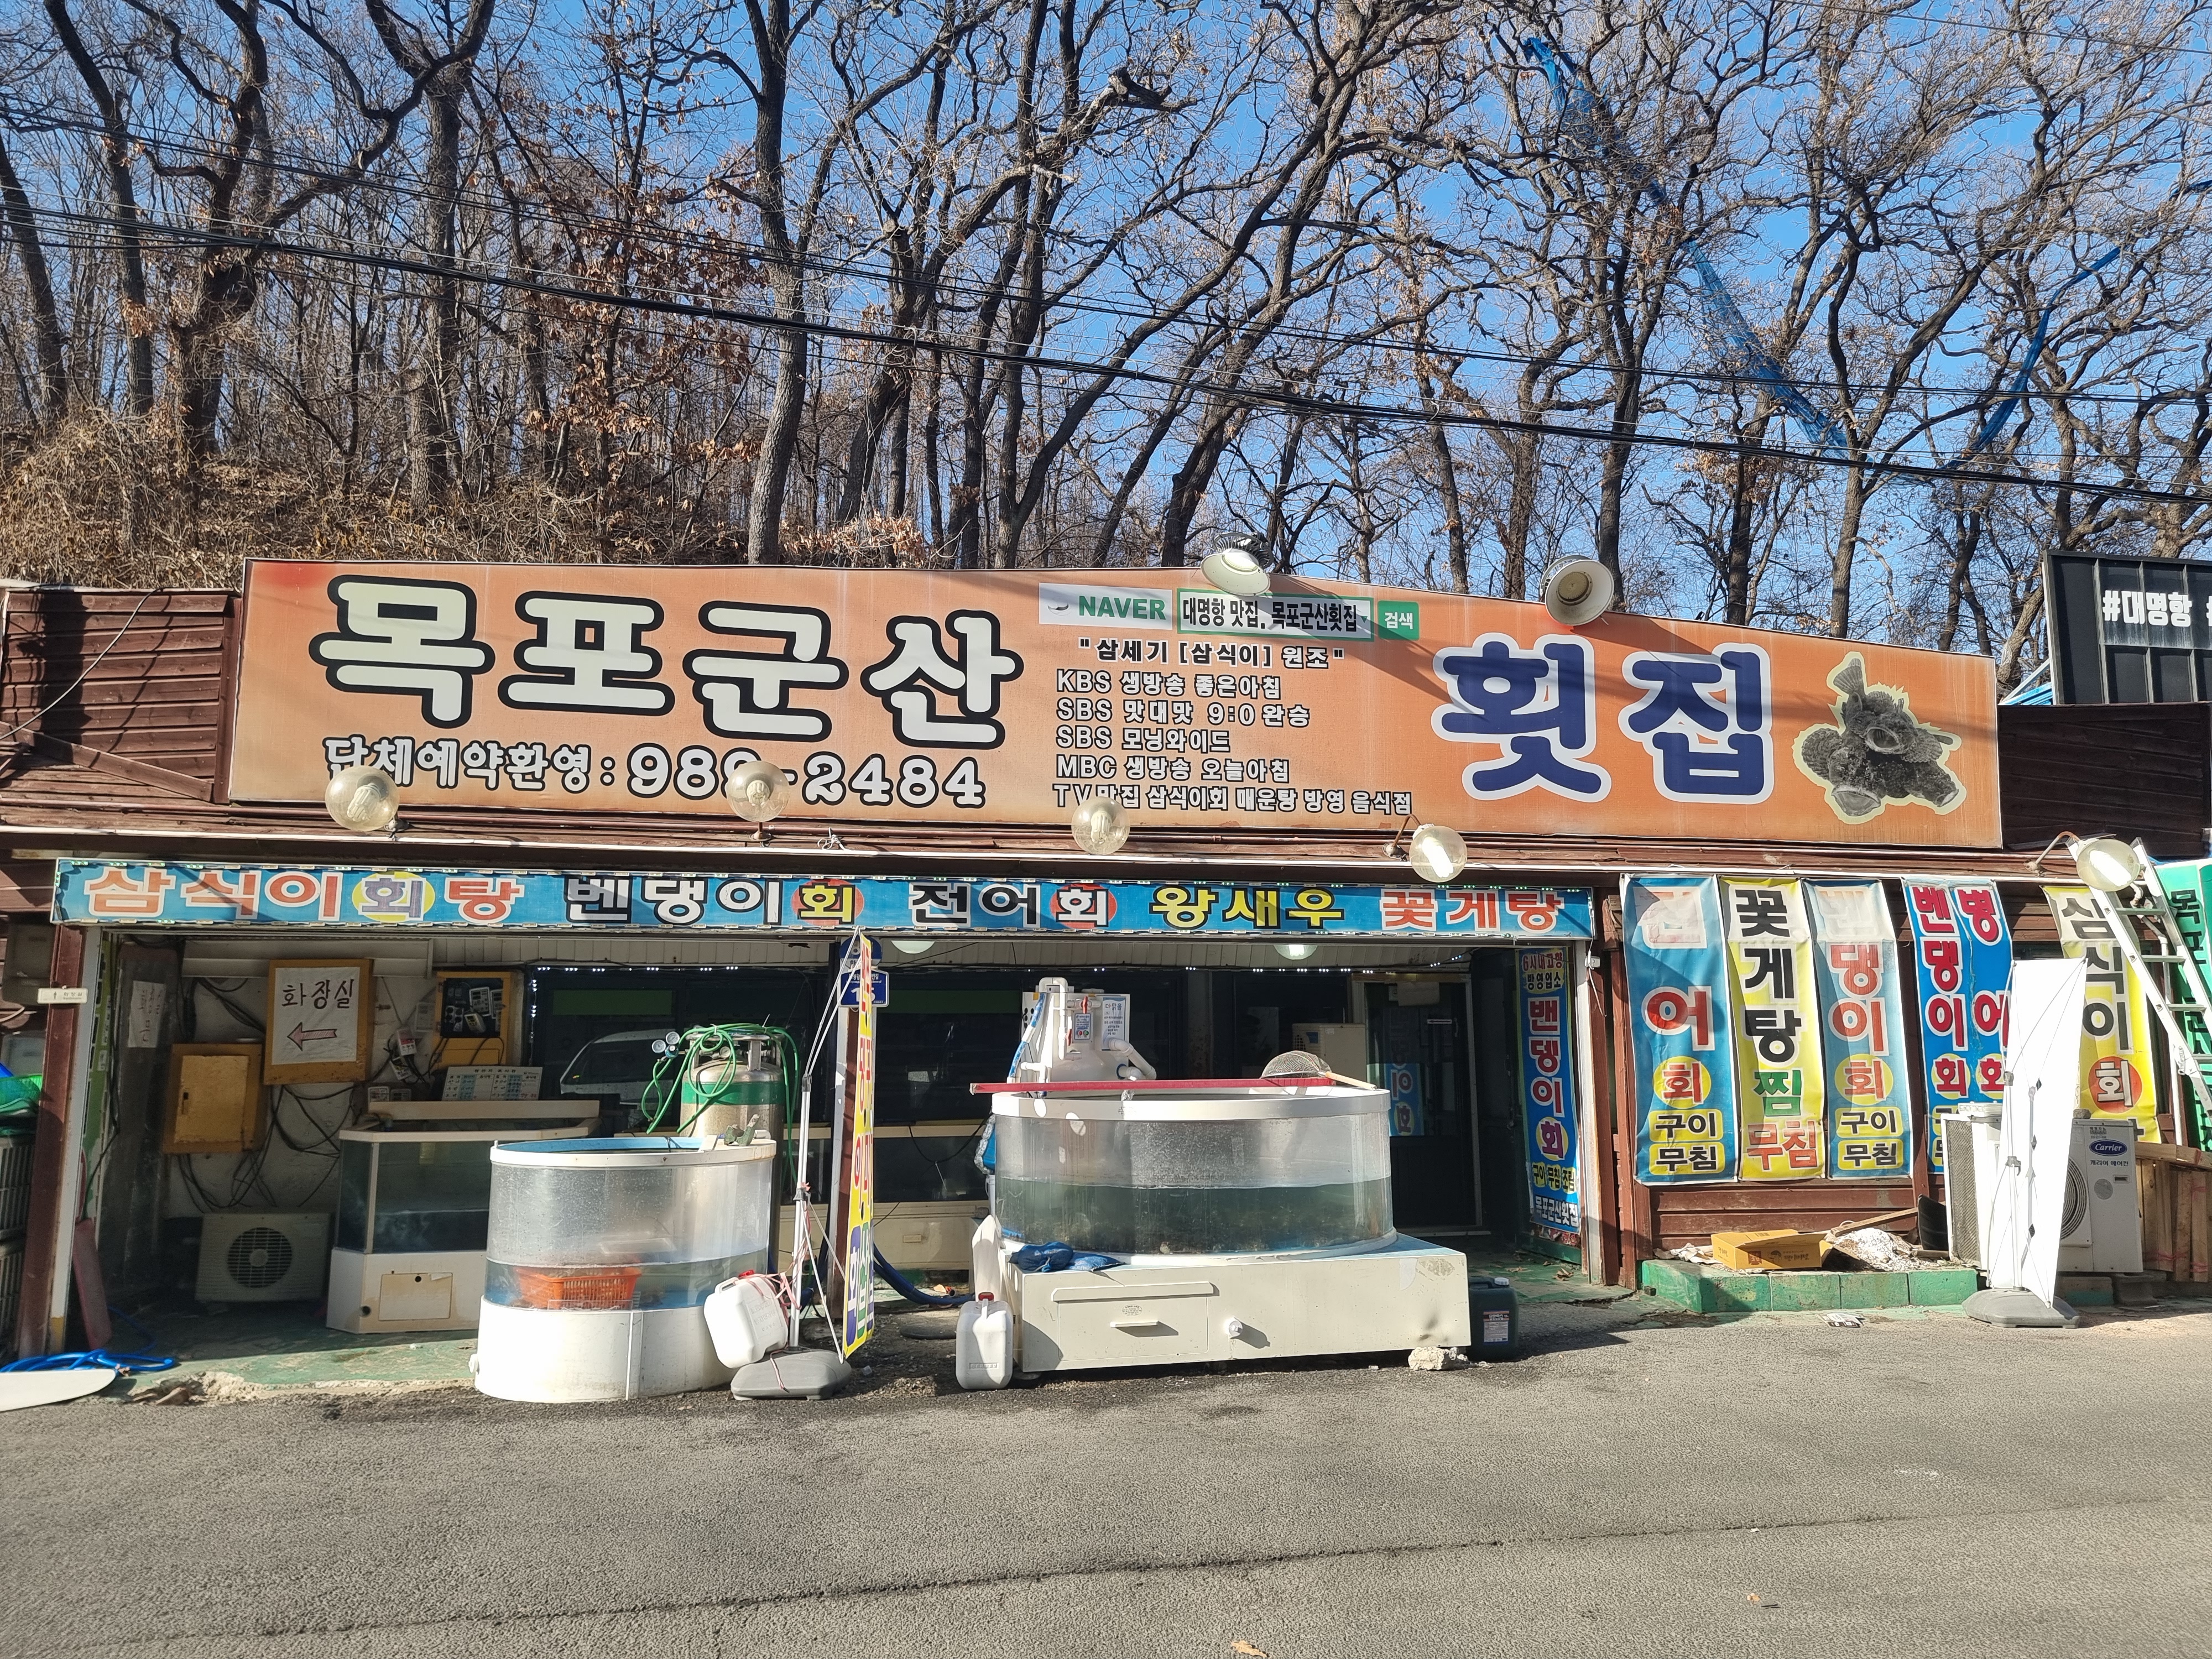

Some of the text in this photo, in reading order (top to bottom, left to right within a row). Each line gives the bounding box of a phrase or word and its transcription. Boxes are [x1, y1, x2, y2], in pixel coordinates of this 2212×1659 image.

[1078, 596, 1166, 620] NAVER
[1183, 597, 1225, 626] 대명항
[1272, 601, 1357, 632] 목포군산횟집
[1384, 612, 1413, 630] 검색
[2103, 590, 2192, 627] #대명항
[309, 575, 1774, 804] 목포군산 횟집
[1057, 669, 1281, 700] KBS 생방송 좋은아침
[1057, 697, 1310, 727] SBS 맛대맛 9:0 완승
[1056, 725, 1230, 753] SBS 모닝와이드
[1056, 754, 1290, 784] MBC 생방송 오늘아침
[1052, 784, 1093, 807] TV
[1146, 785, 1229, 811] 삼식이회
[1235, 787, 1298, 812] 매운탕
[1303, 789, 1345, 813] 방영
[1351, 791, 1412, 815] 음식점
[1150, 885, 1344, 931] 왕새우
[1380, 888, 1563, 933] 꽃게탕
[1523, 952, 1562, 972] 6시내고향
[1734, 888, 1803, 1065] 꽃게탕
[282, 979, 354, 1009] 화장실
[1527, 972, 1561, 990] 방영업소
[1754, 1070, 1801, 1117] 찜
[1655, 1112, 1717, 1138] 구이
[1841, 1110, 1896, 1134] 구이
[1656, 1145, 1717, 1171] 무침
[1746, 1120, 1817, 1171] 무침
[1843, 1142, 1897, 1167] 무침
[1533, 1164, 1575, 1192] 구이 무침 조림
[1535, 1196, 1579, 1227] 목포군산횟집
